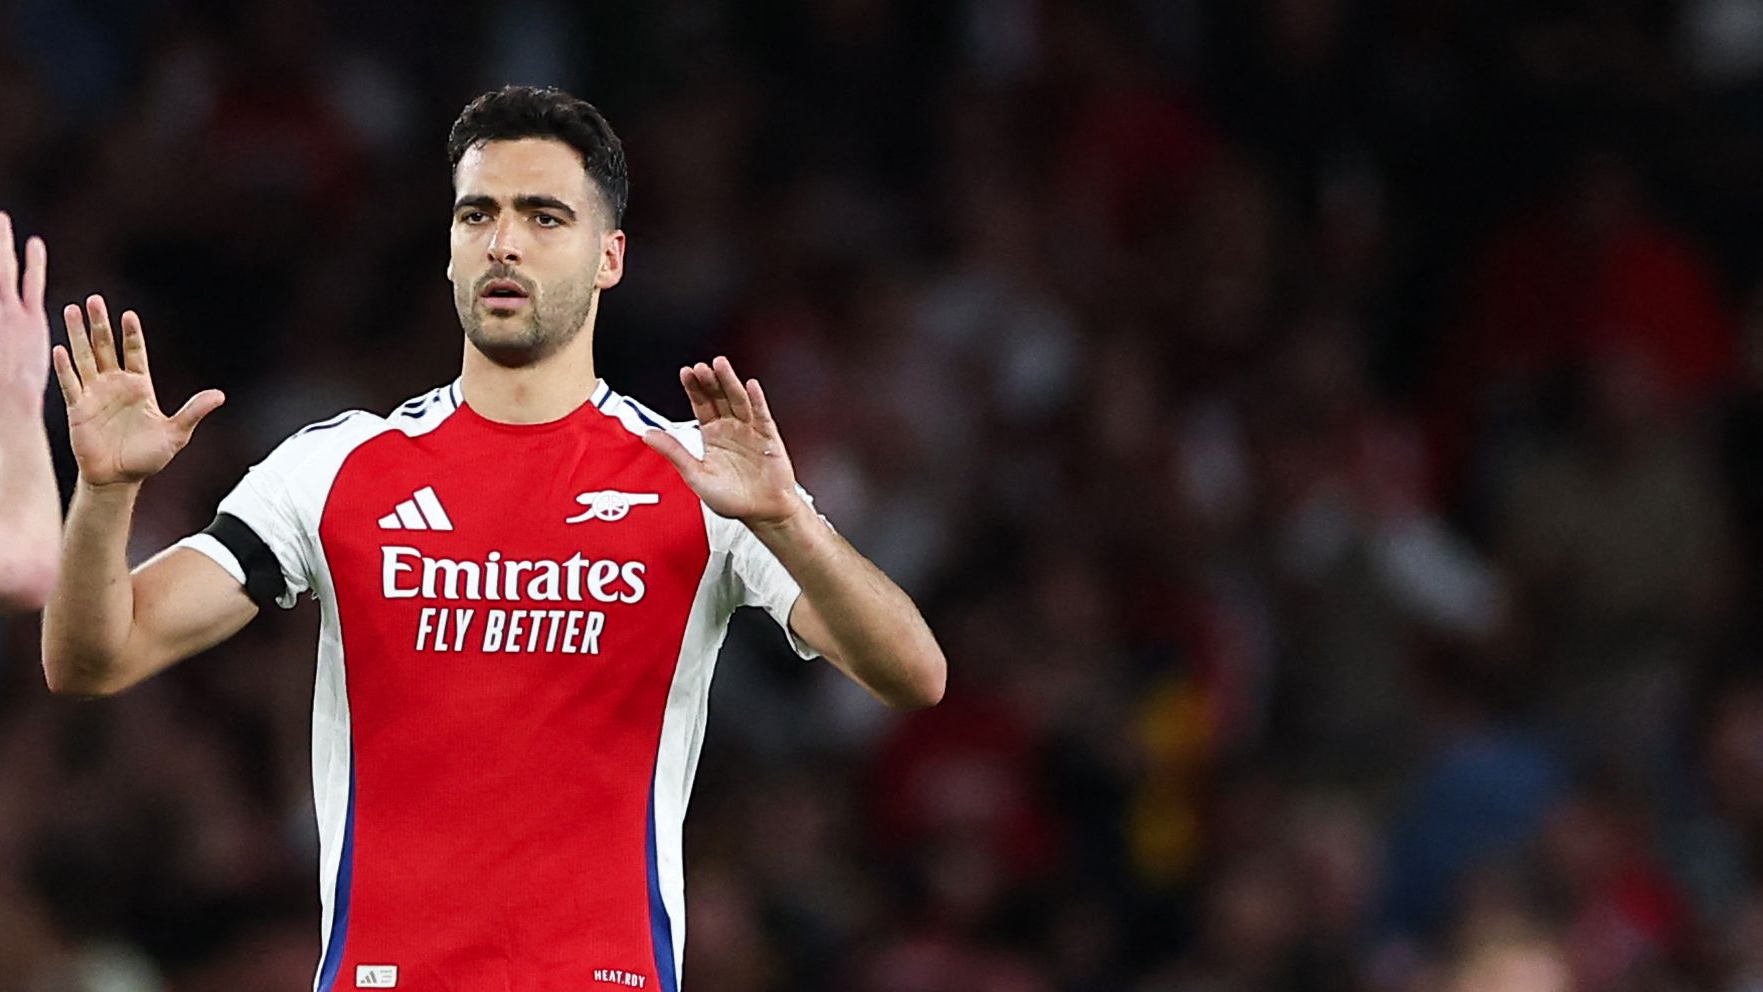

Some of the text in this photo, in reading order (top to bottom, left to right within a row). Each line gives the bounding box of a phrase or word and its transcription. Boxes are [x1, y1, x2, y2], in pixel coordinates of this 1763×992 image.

[381, 546, 646, 603] Emirates
[416, 608, 605, 654] FLY BETTER
[594, 969, 646, 988] HEAT.RDY
